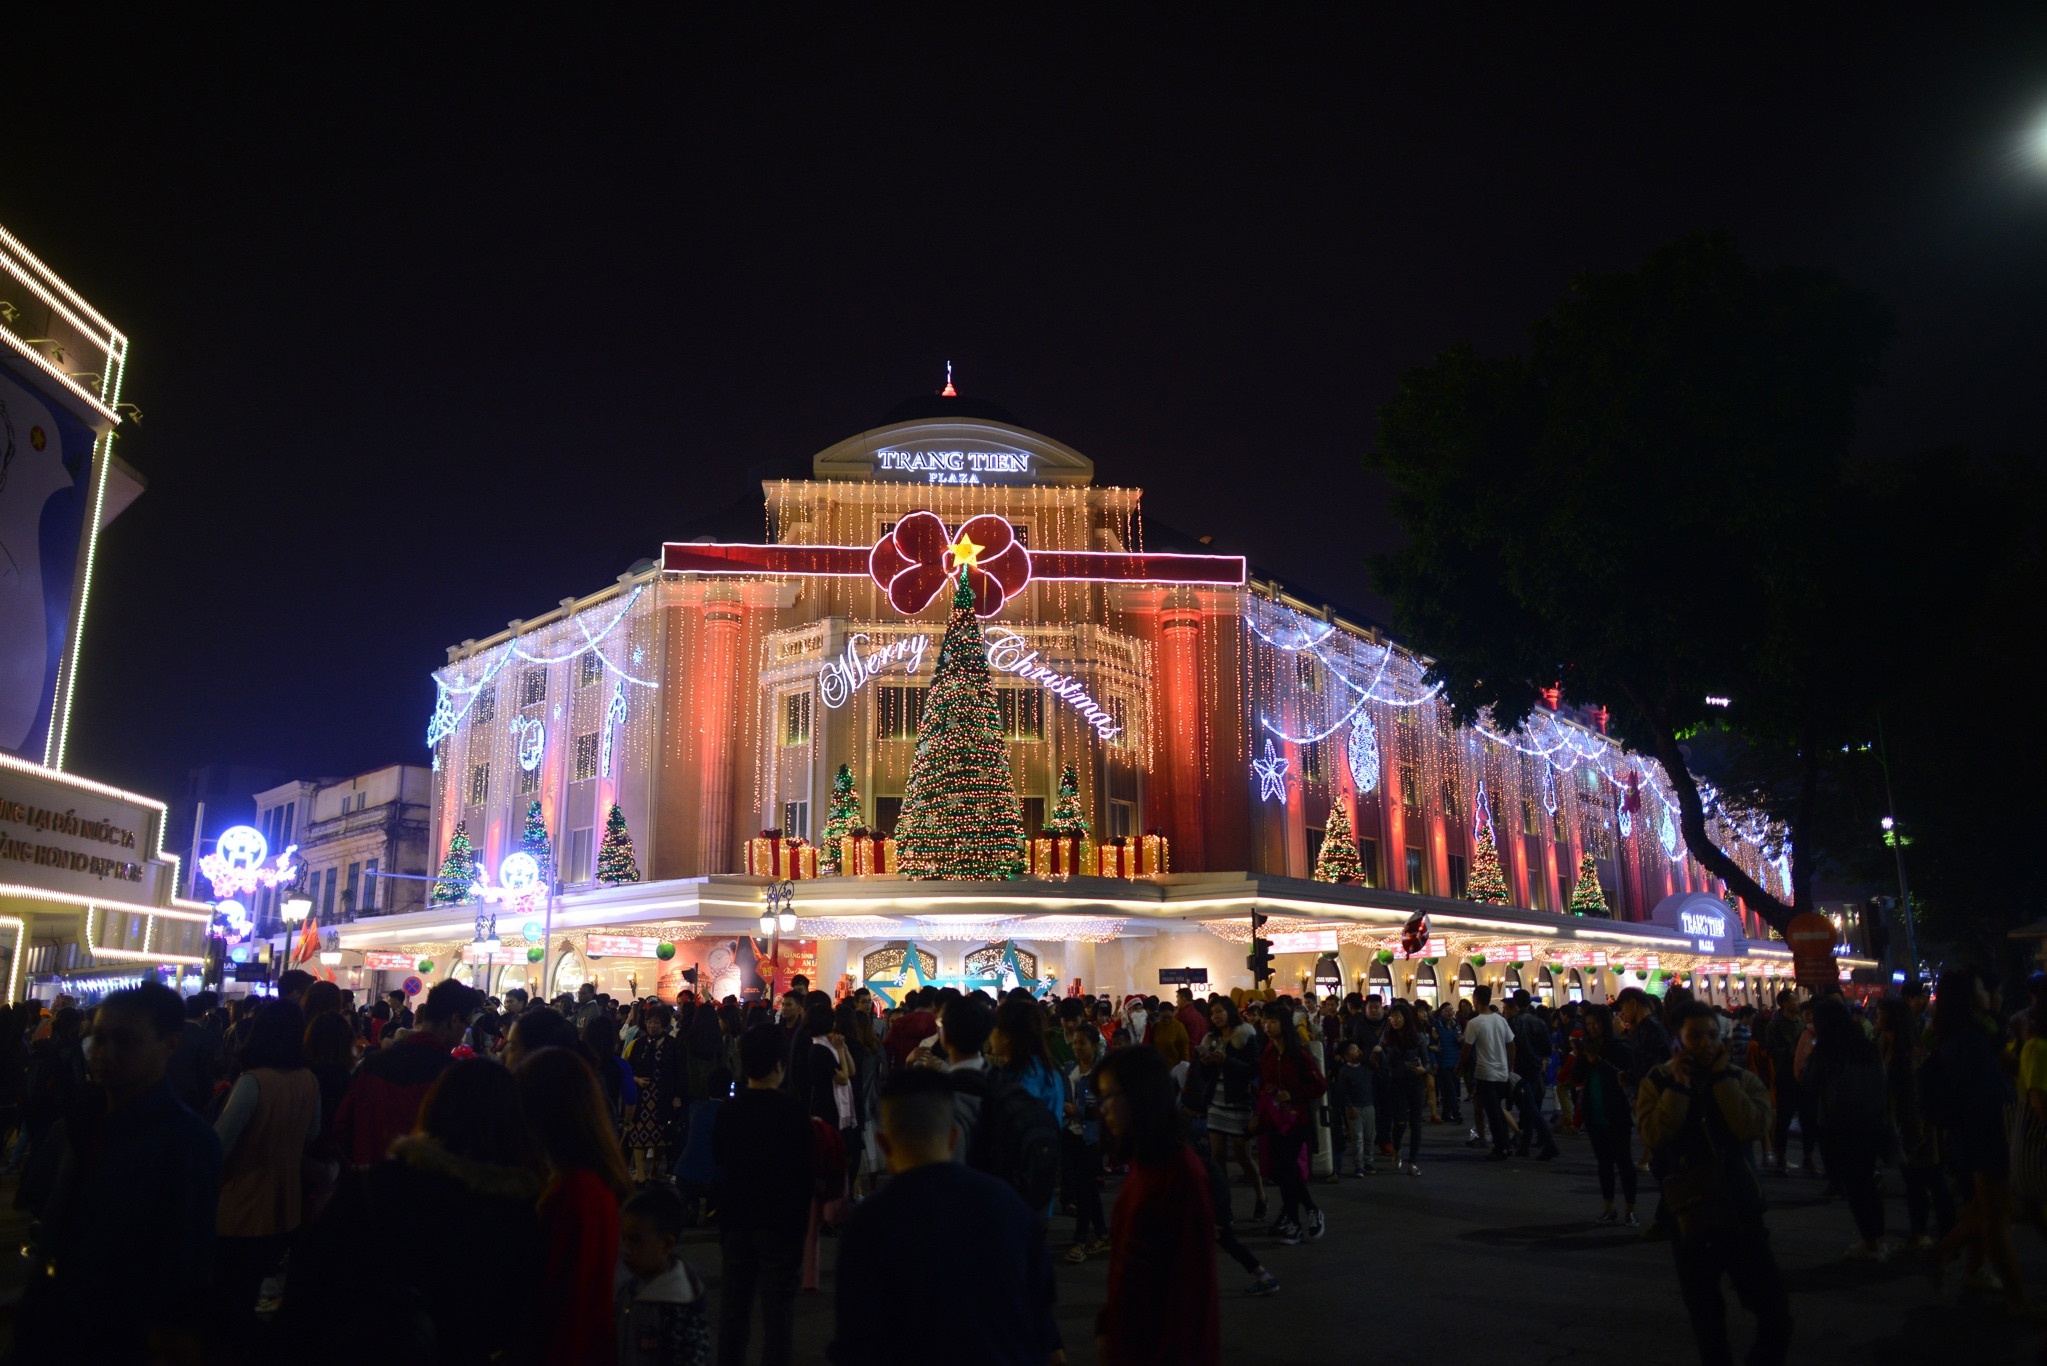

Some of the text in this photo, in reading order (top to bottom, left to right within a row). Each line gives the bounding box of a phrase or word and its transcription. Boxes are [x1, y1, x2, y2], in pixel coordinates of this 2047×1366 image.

[878, 451, 1030, 472] TRANG TIEN
[929, 473, 980, 484] PLAZA
[819, 627, 1123, 741] Merry Christmas
